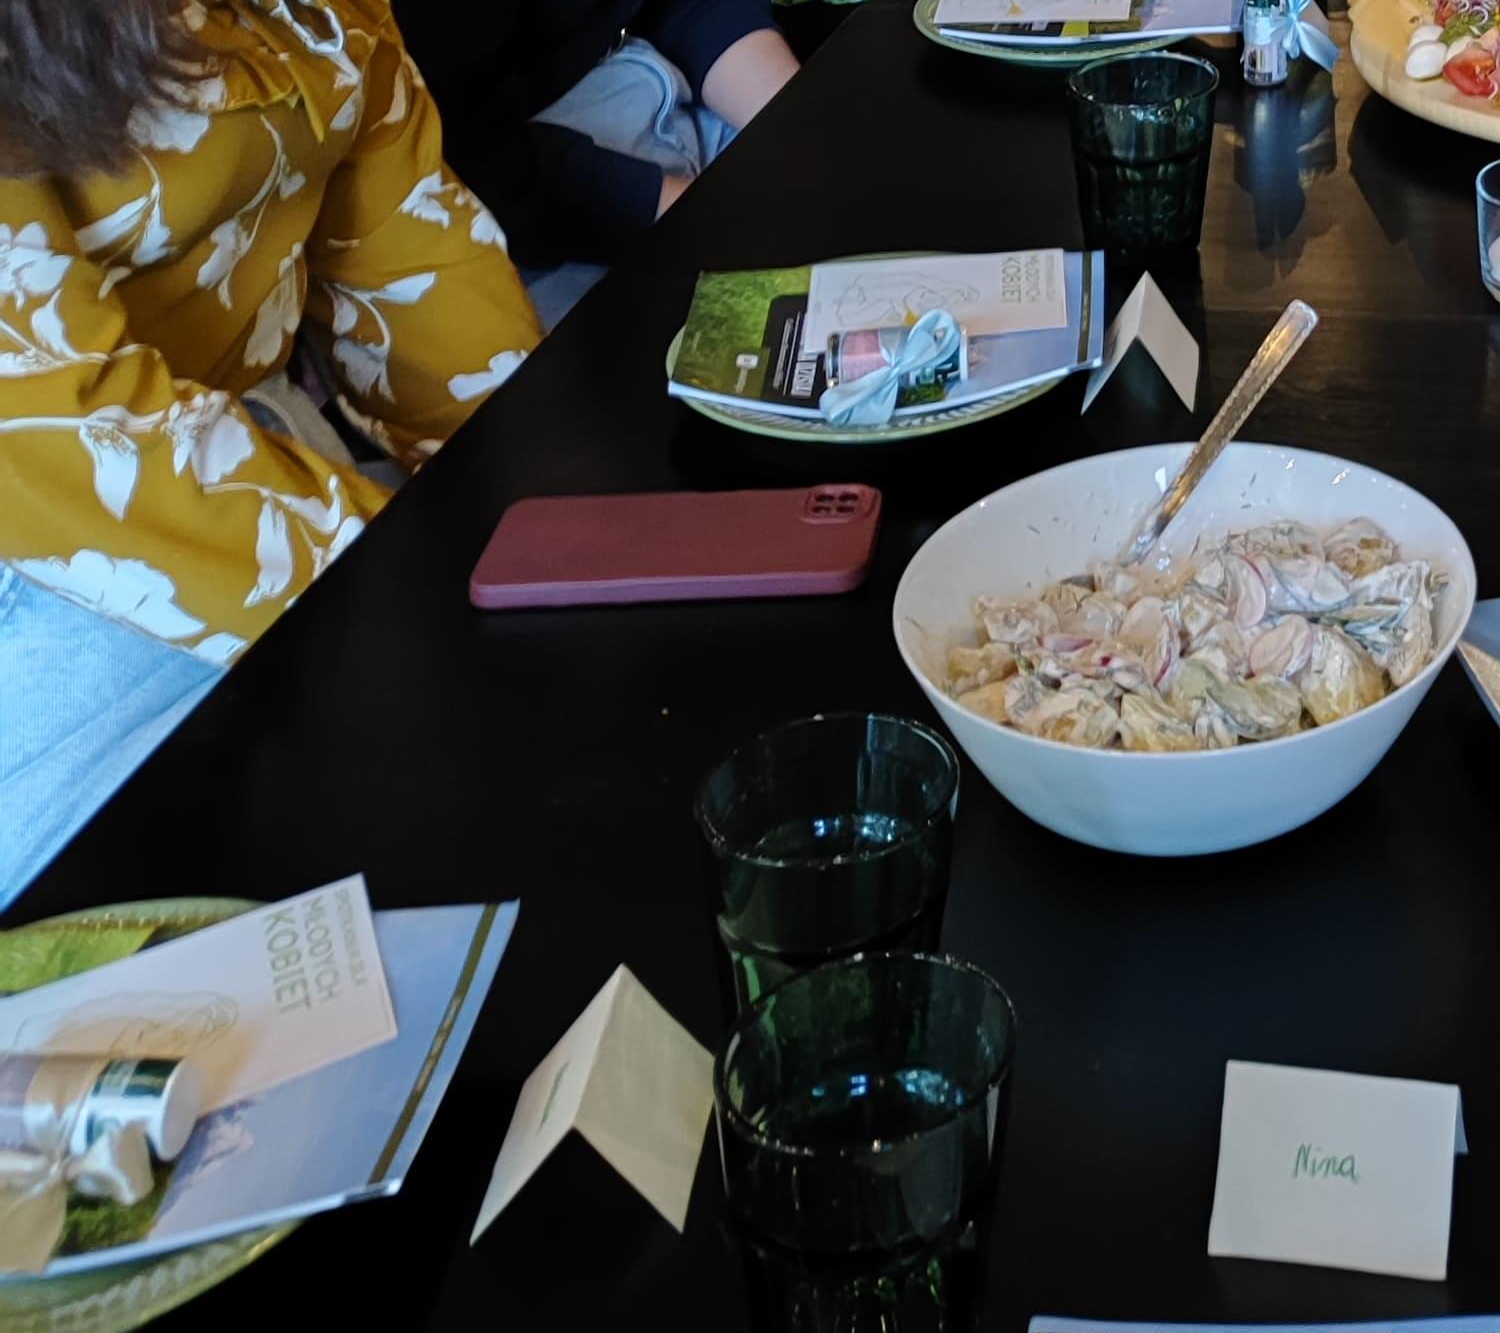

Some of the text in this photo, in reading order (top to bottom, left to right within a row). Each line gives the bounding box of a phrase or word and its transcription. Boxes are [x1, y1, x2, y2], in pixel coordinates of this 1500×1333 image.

[262, 906, 311, 1014] KOBIET
[302, 895, 343, 1005] MŁODYCH
[1292, 1142, 1360, 1185] Nina
